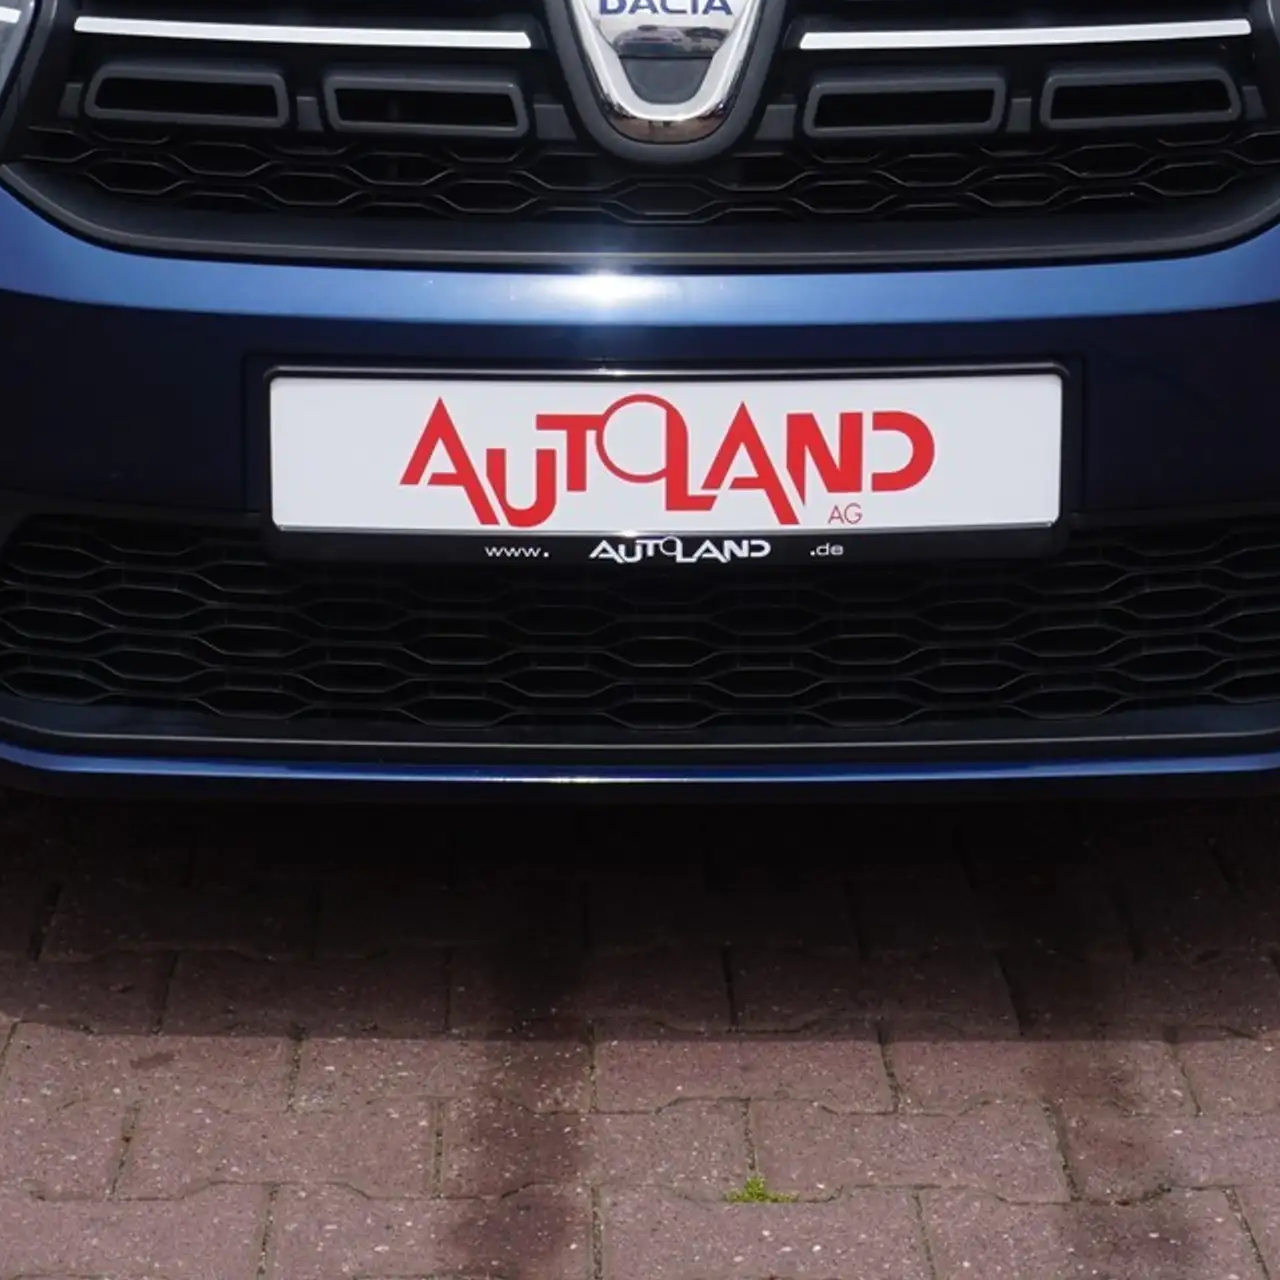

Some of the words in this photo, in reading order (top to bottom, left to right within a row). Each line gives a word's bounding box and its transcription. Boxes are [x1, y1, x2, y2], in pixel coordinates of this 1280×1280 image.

[400, 393, 936, 528] AUTOLAND
[828, 503, 862, 525] AG
[484, 544, 550, 558] www.
[588, 536, 772, 564] AUTOLAND
[808, 542, 845, 557] .de
